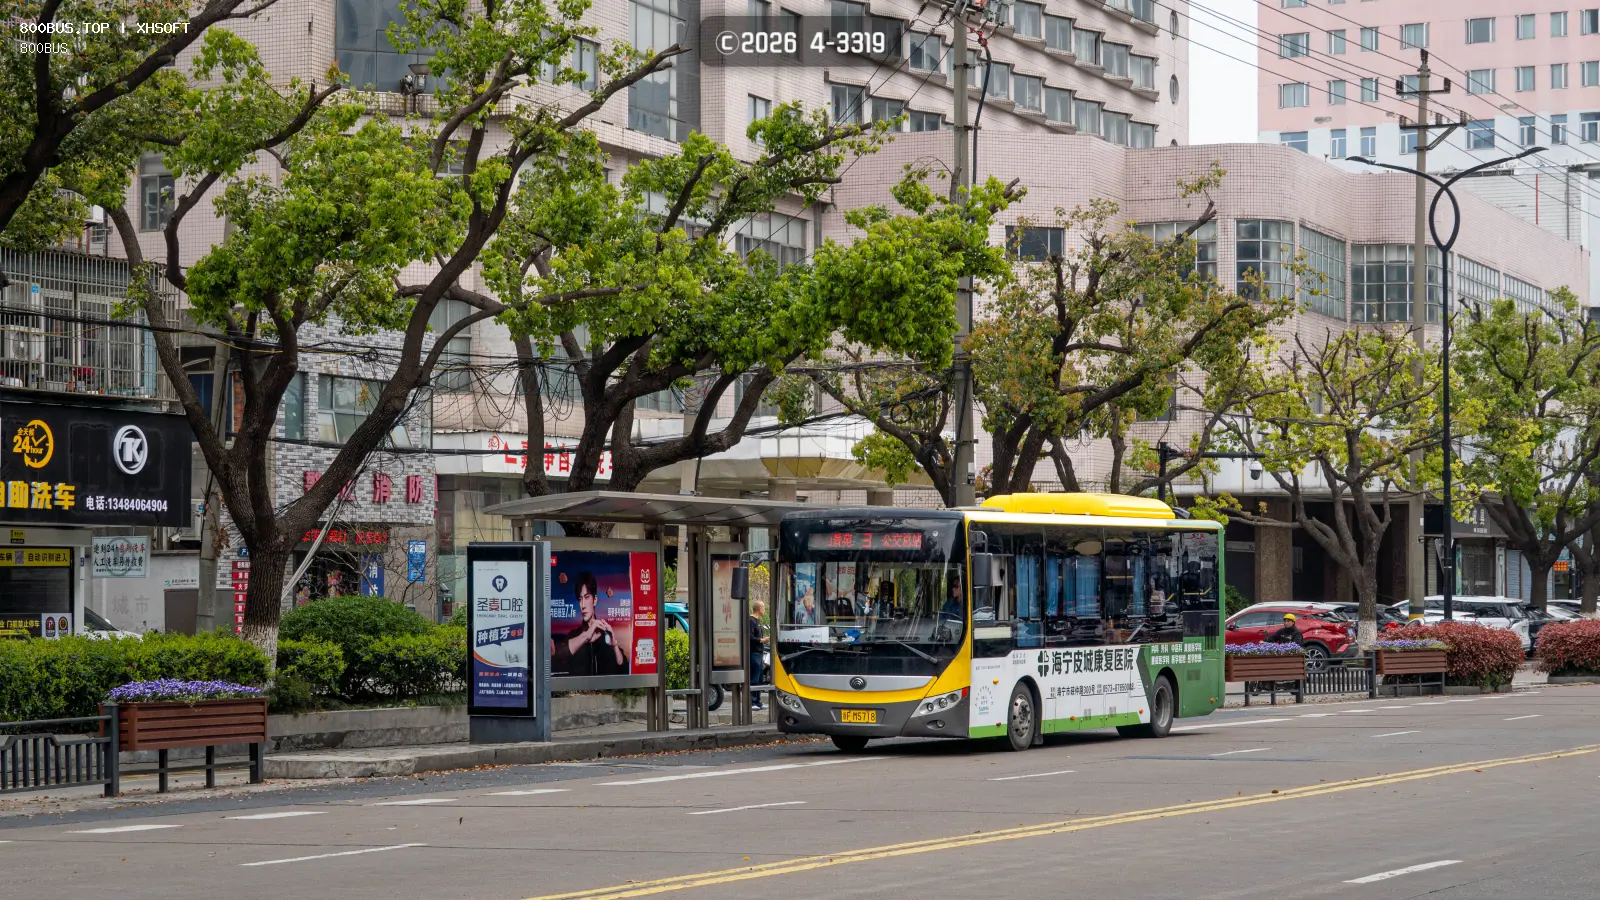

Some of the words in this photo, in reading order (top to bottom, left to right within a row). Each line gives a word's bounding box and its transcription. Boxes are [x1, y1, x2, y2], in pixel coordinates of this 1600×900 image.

[13, 435, 30, 453] 24
[30, 447, 43, 455] hour
[0, 481, 76, 511] 助洗车
[862, 533, 872, 548] 3
[882, 532, 922, 548] 公交总站
[28, 552, 68, 562] 自动识别进入
[477, 597, 523, 612] 圣麦口腔
[1051, 648, 1134, 675] 海宁皮城康复医院
